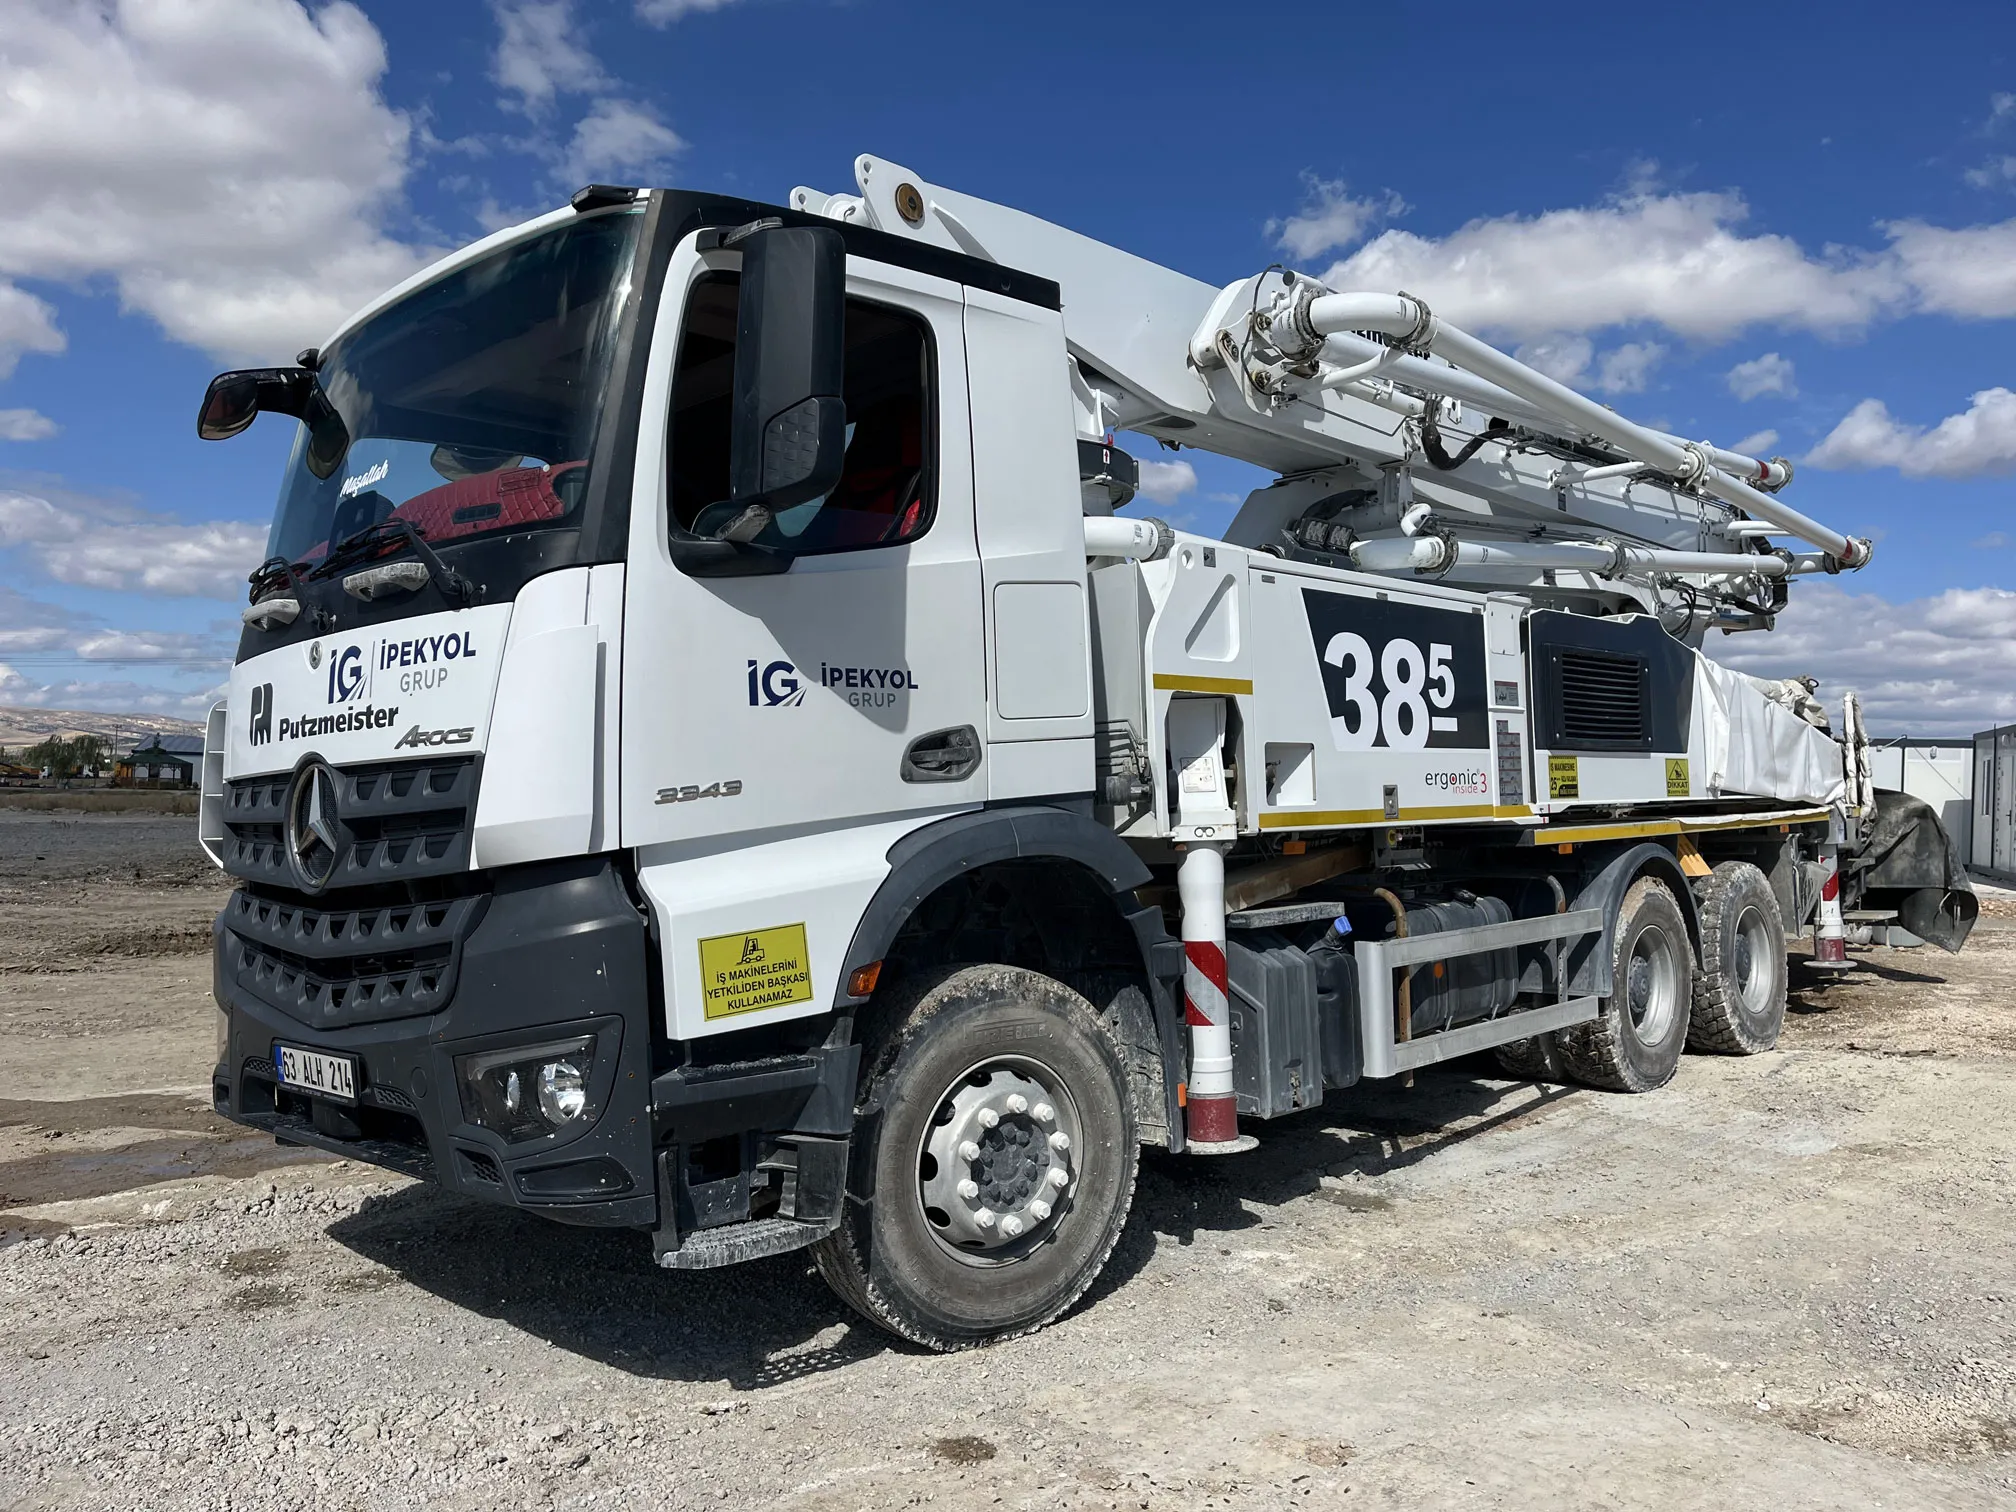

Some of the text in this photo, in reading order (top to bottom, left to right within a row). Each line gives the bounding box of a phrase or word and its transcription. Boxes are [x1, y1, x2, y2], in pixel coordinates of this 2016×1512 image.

[400, 667, 448, 693] GRUP
[848, 692, 896, 708] GRUP
[279, 704, 399, 742] Putzmeister
[654, 779, 743, 805] 3343
[1453, 784, 1478, 794] inside
[716, 957, 798, 985] İŞ MAKİNELERİNİ
[707, 972, 809, 999] YETKİLİDEN BAŞKASI
[727, 989, 793, 1011] KULLANAMAZ
[283, 1051, 296, 1081] 63
[303, 1055, 324, 1087] ALH
[329, 1060, 352, 1094] 214
